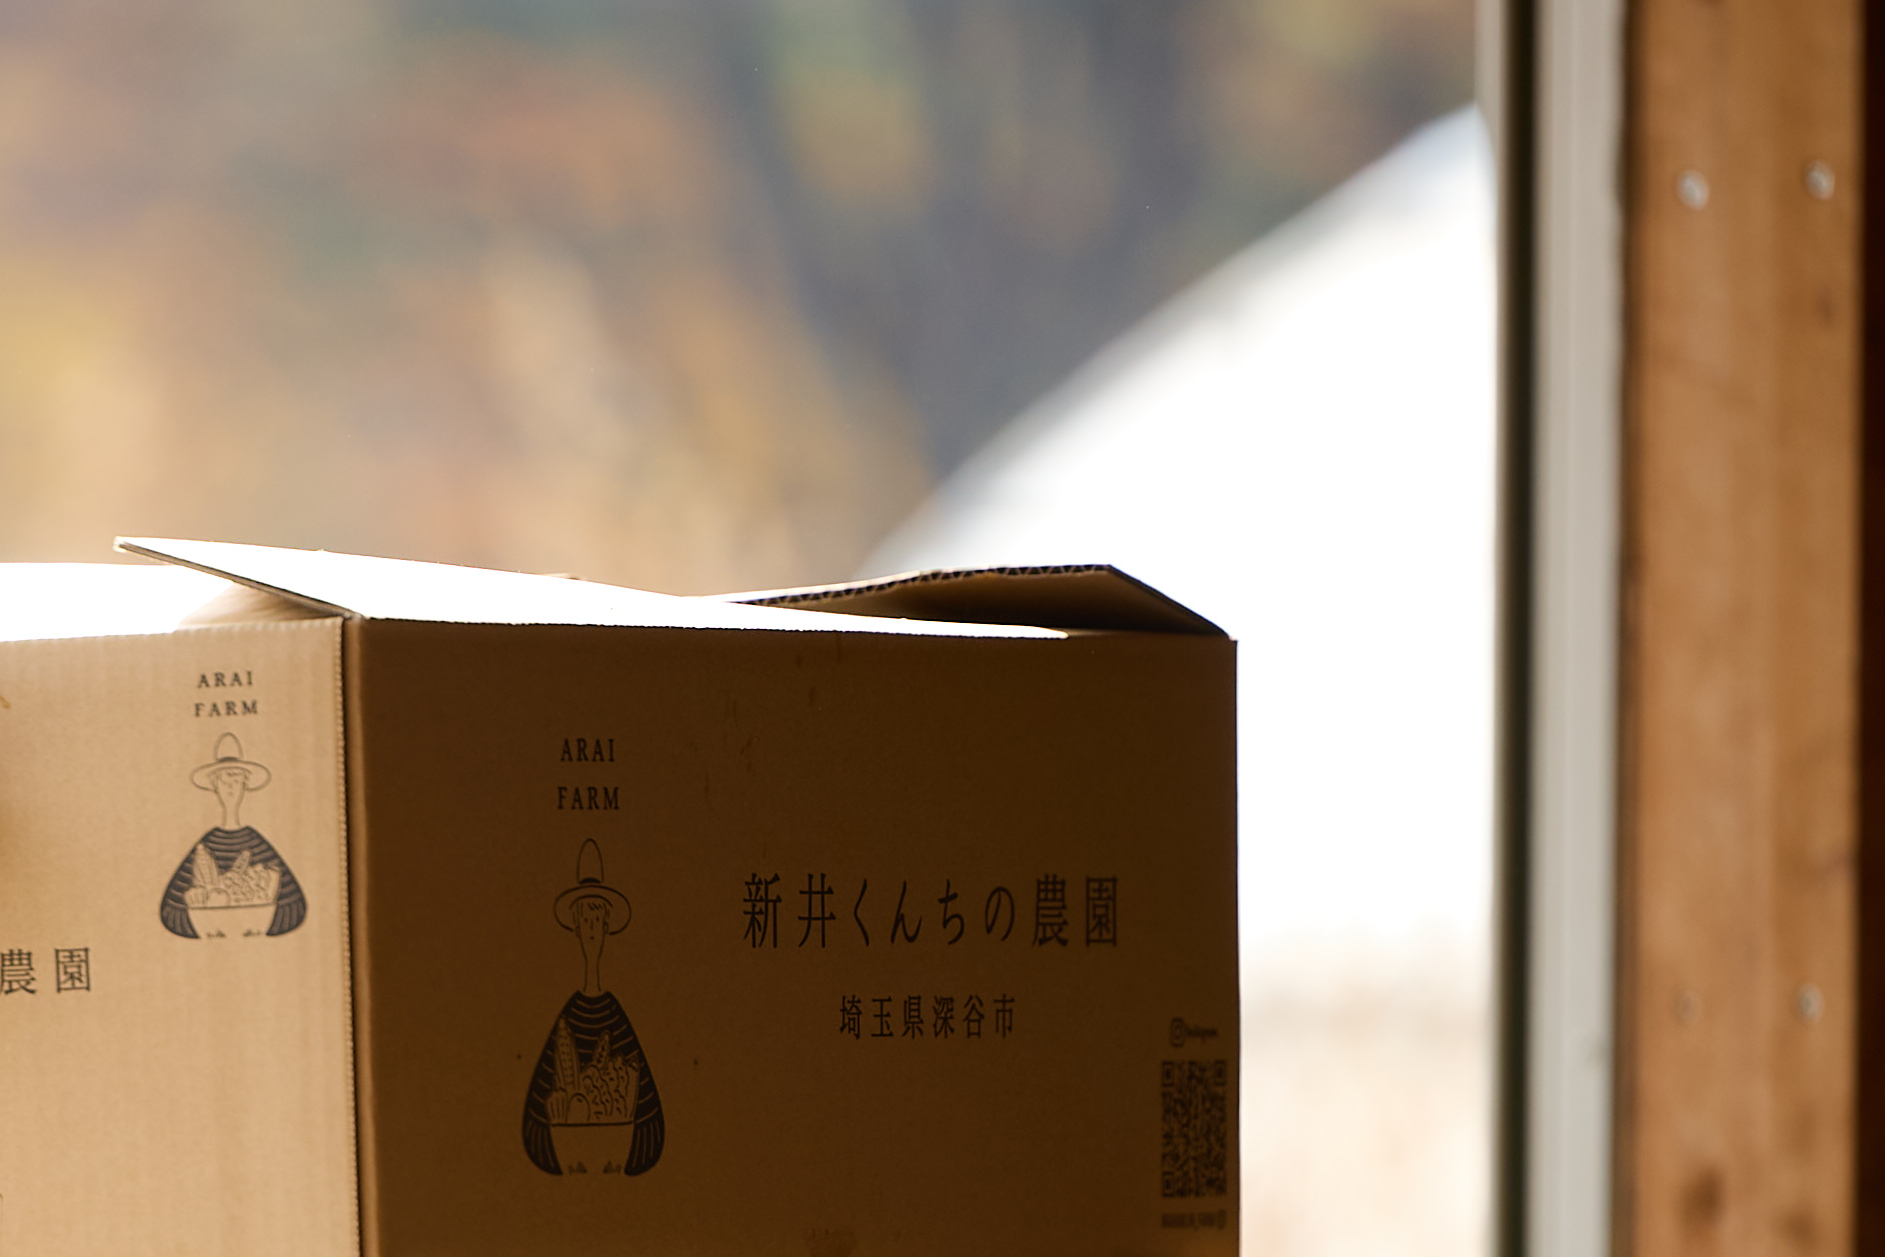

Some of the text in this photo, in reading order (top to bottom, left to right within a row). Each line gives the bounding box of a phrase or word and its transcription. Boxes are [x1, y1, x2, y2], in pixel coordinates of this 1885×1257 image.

[197, 671, 252, 689] ARAI
[195, 700, 258, 717] FARM
[560, 738, 614, 762] ARAI
[558, 786, 619, 810] FARM
[743, 872, 1117, 948] 新井くんちの農園
[839, 994, 1015, 1040] 埼玉県深谷市
